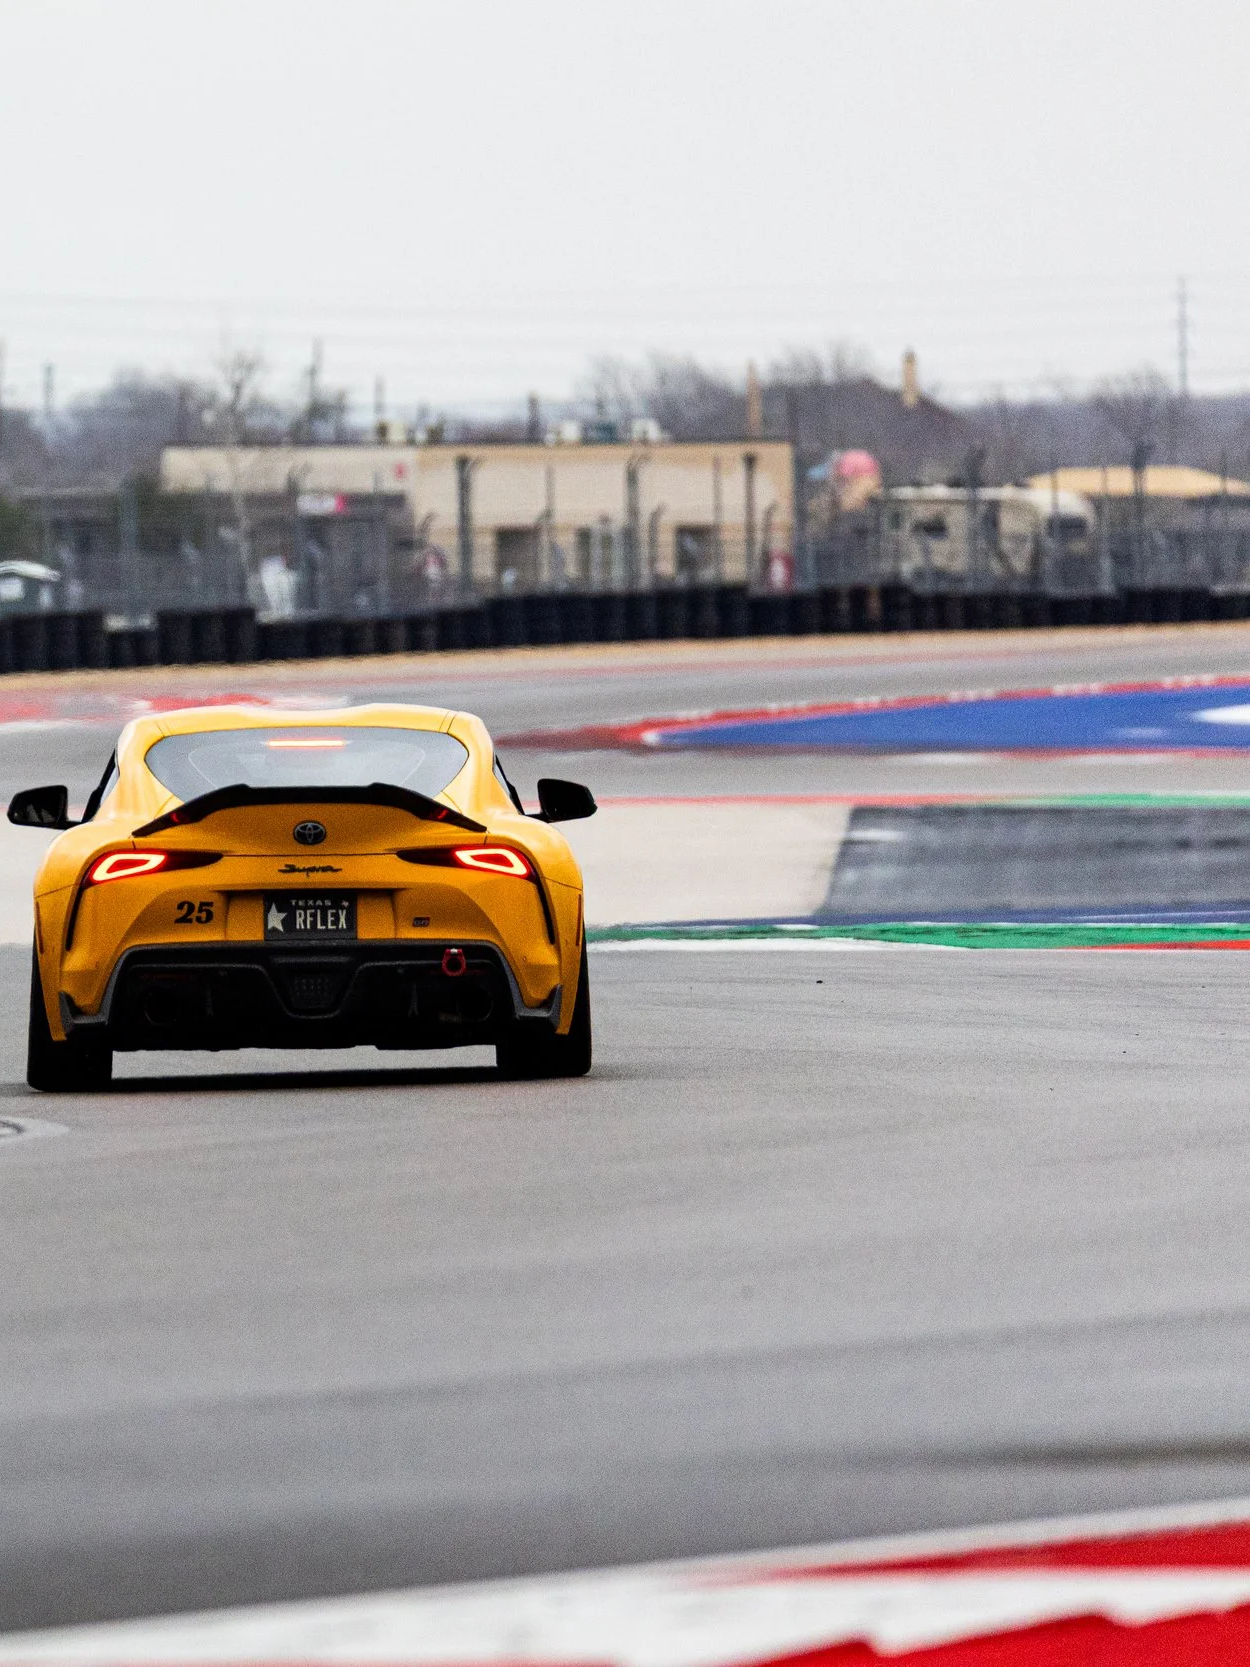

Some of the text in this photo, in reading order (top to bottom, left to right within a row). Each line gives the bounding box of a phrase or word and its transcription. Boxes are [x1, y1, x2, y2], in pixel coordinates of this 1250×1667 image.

[174, 900, 214, 924] 25
[290, 898, 332, 907] TEXAS
[296, 909, 347, 929] RFLEX
